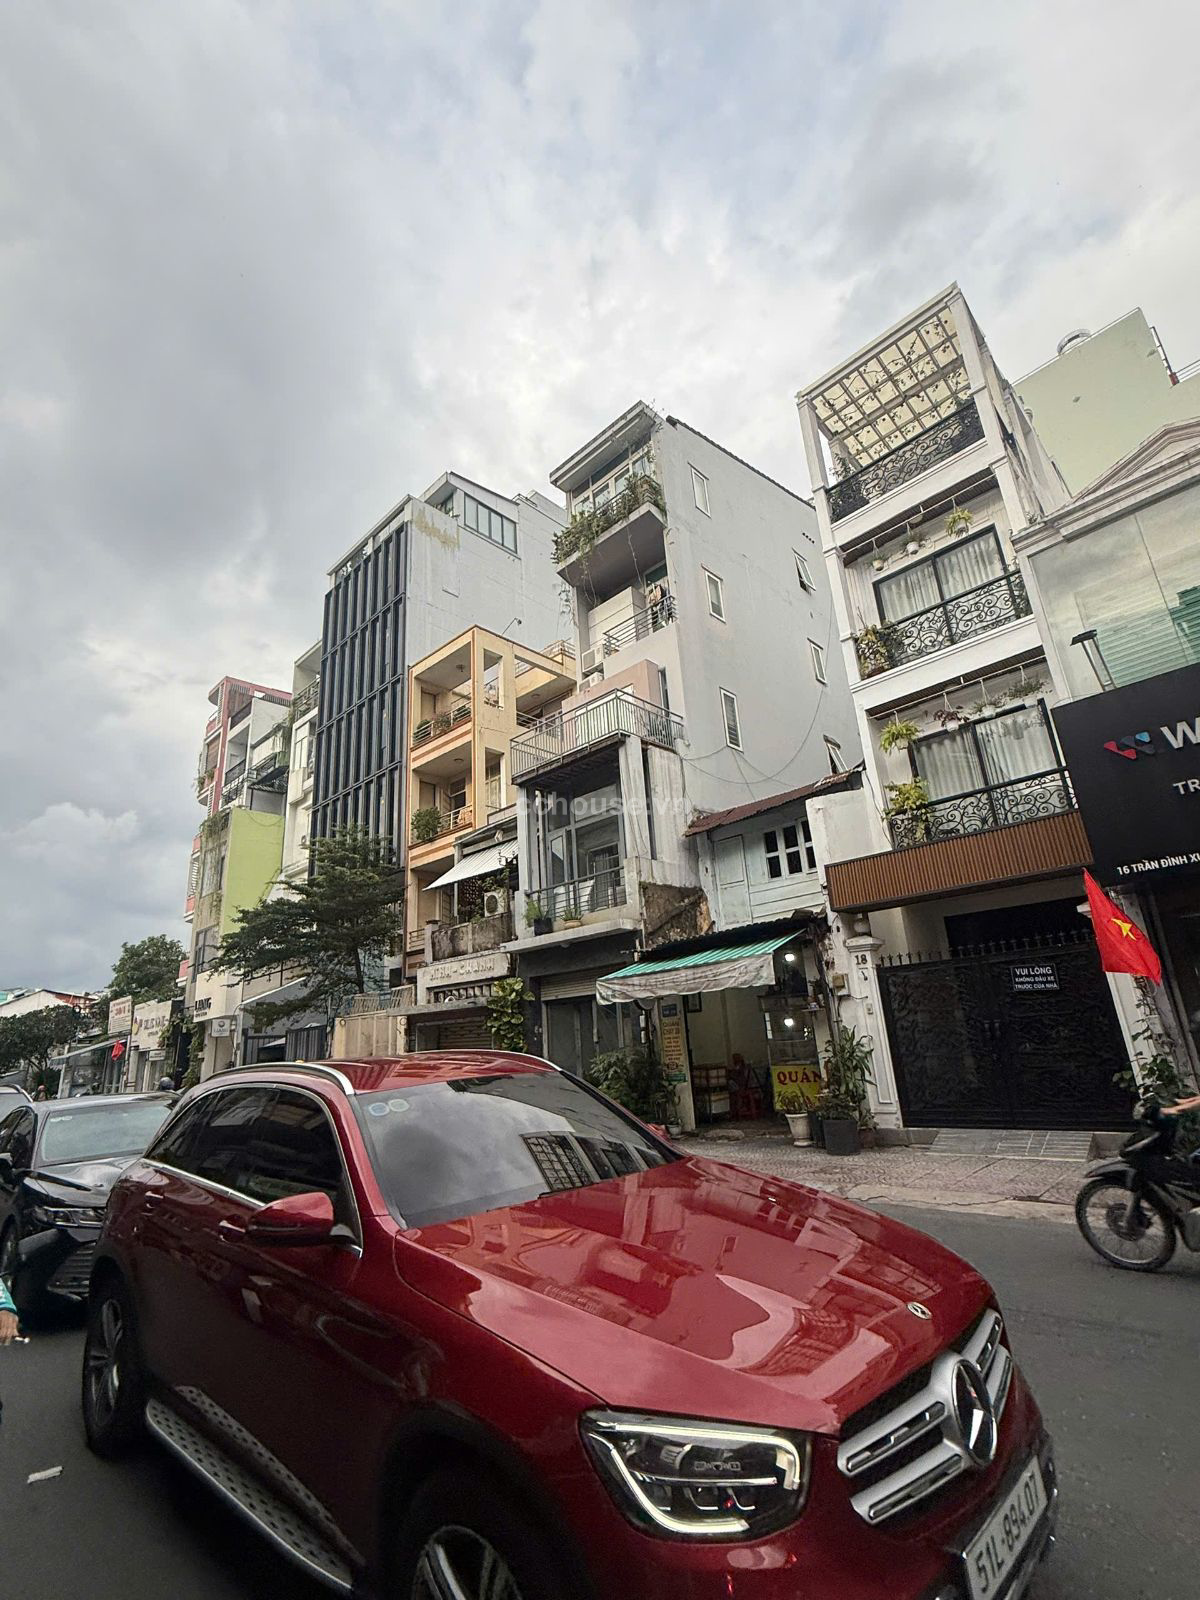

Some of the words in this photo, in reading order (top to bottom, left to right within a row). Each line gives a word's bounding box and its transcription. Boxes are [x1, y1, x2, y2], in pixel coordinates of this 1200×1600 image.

[1117, 865, 1130, 876] 16
[1131, 860, 1160, 873] TRẦN
[1160, 856, 1188, 868] ĐÌNH
[854, 954, 868, 966] 18
[1029, 966, 1052, 975] LÒNG
[976, 1470, 1040, 1593] 51L-894.07
